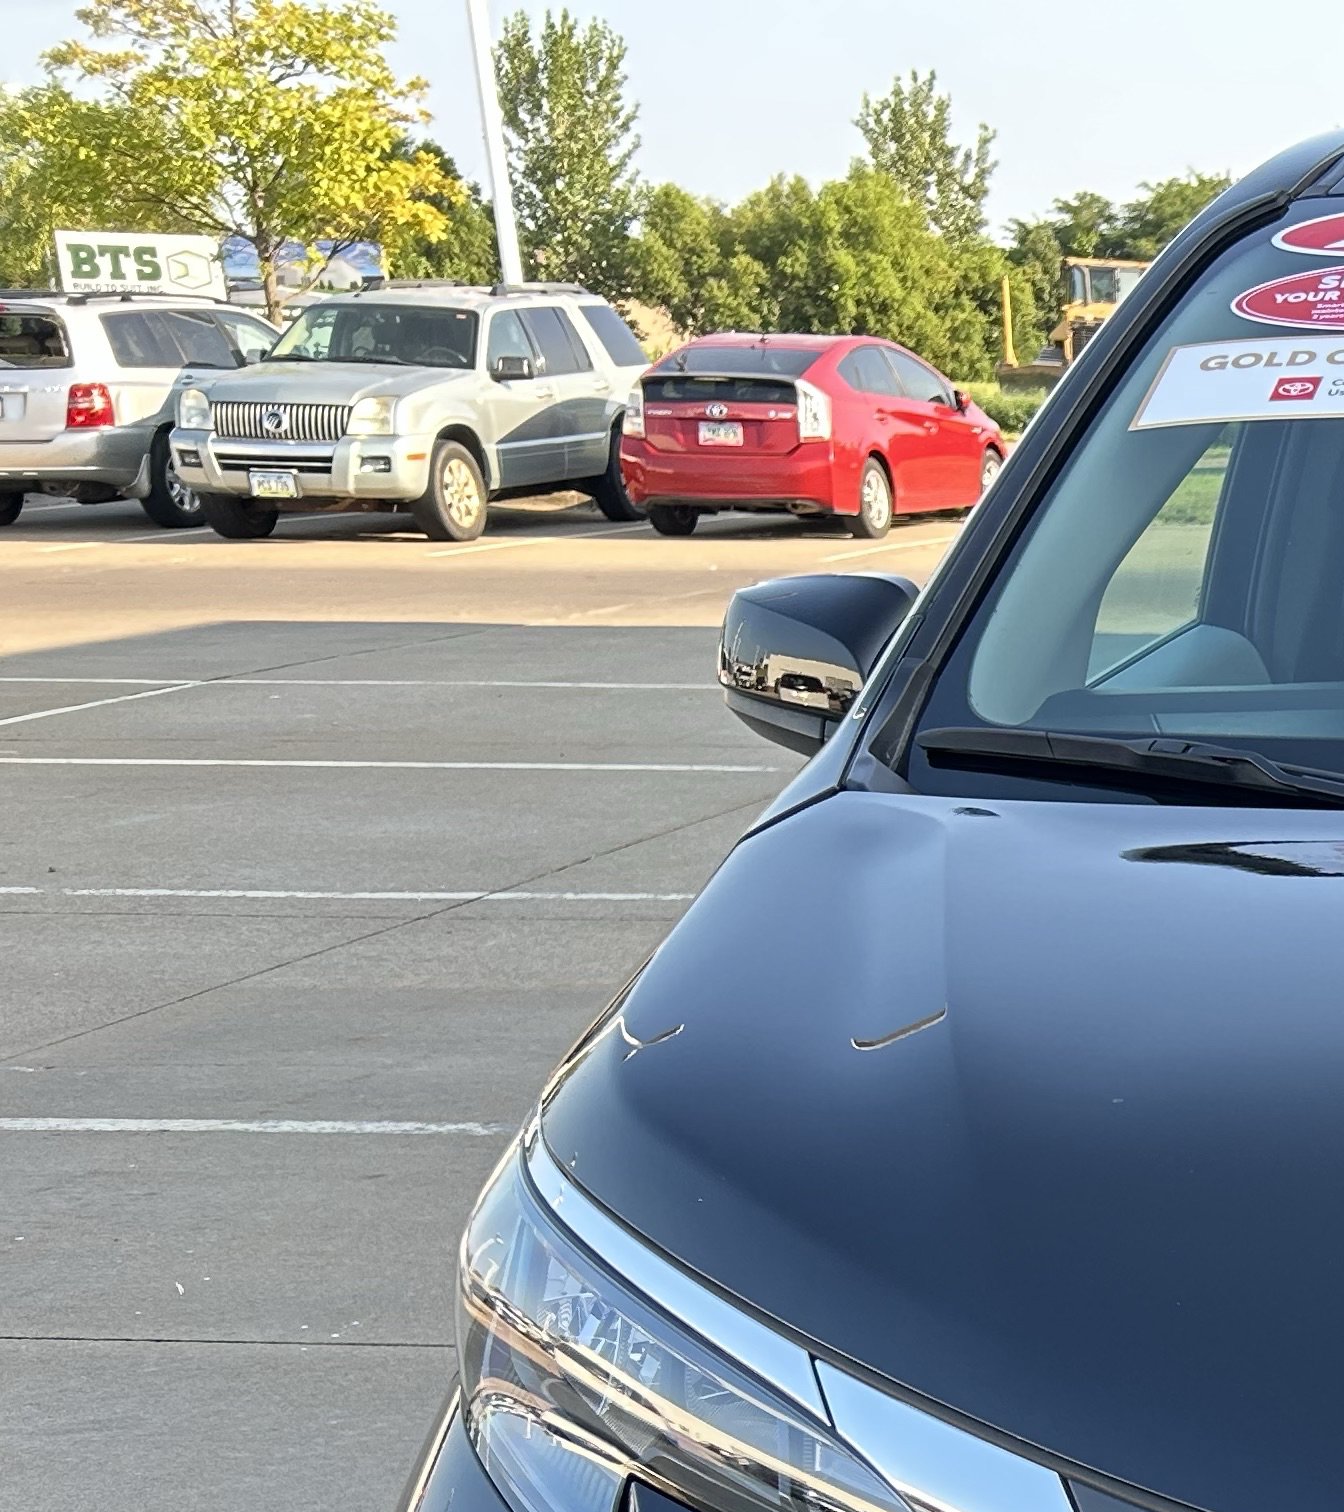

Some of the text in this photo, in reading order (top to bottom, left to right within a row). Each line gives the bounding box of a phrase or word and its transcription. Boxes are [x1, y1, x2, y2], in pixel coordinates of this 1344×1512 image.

[66, 243, 162, 281] BTS
[1274, 290, 1341, 304] YOUR
[1199, 350, 1317, 372] GOLD
